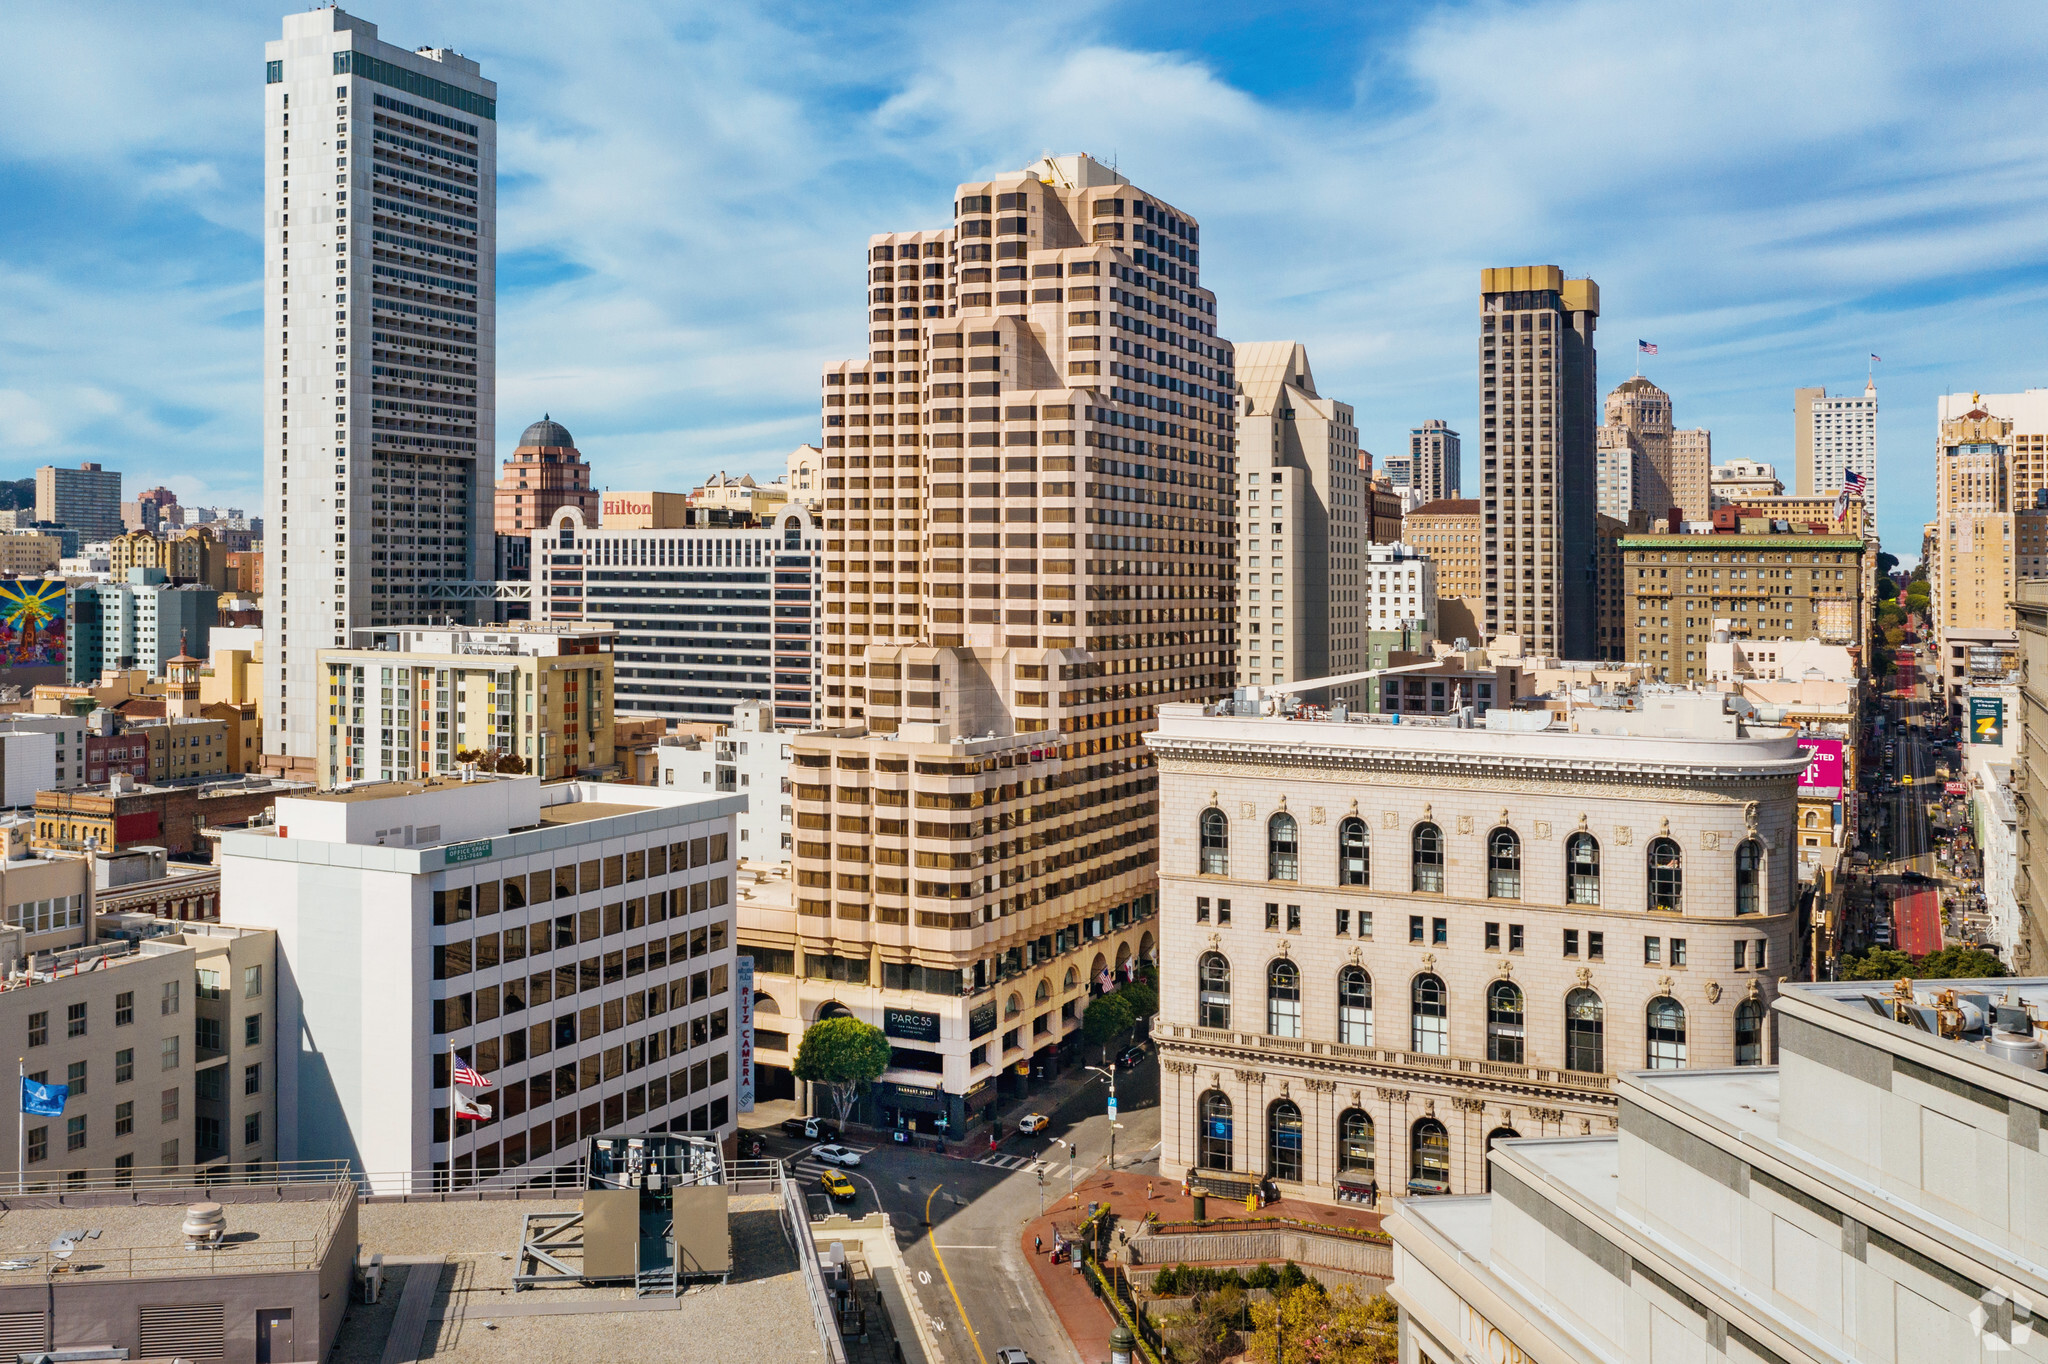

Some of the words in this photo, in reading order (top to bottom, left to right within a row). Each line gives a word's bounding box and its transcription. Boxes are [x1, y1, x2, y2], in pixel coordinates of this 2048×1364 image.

[603, 499, 652, 515] Hilton
[449, 849, 470, 857] OFFICE
[741, 986, 750, 1024] RITZ
[891, 1013, 920, 1025] PARC
[920, 1016, 932, 1027] 55
[741, 1029, 751, 1086] CAMERA
